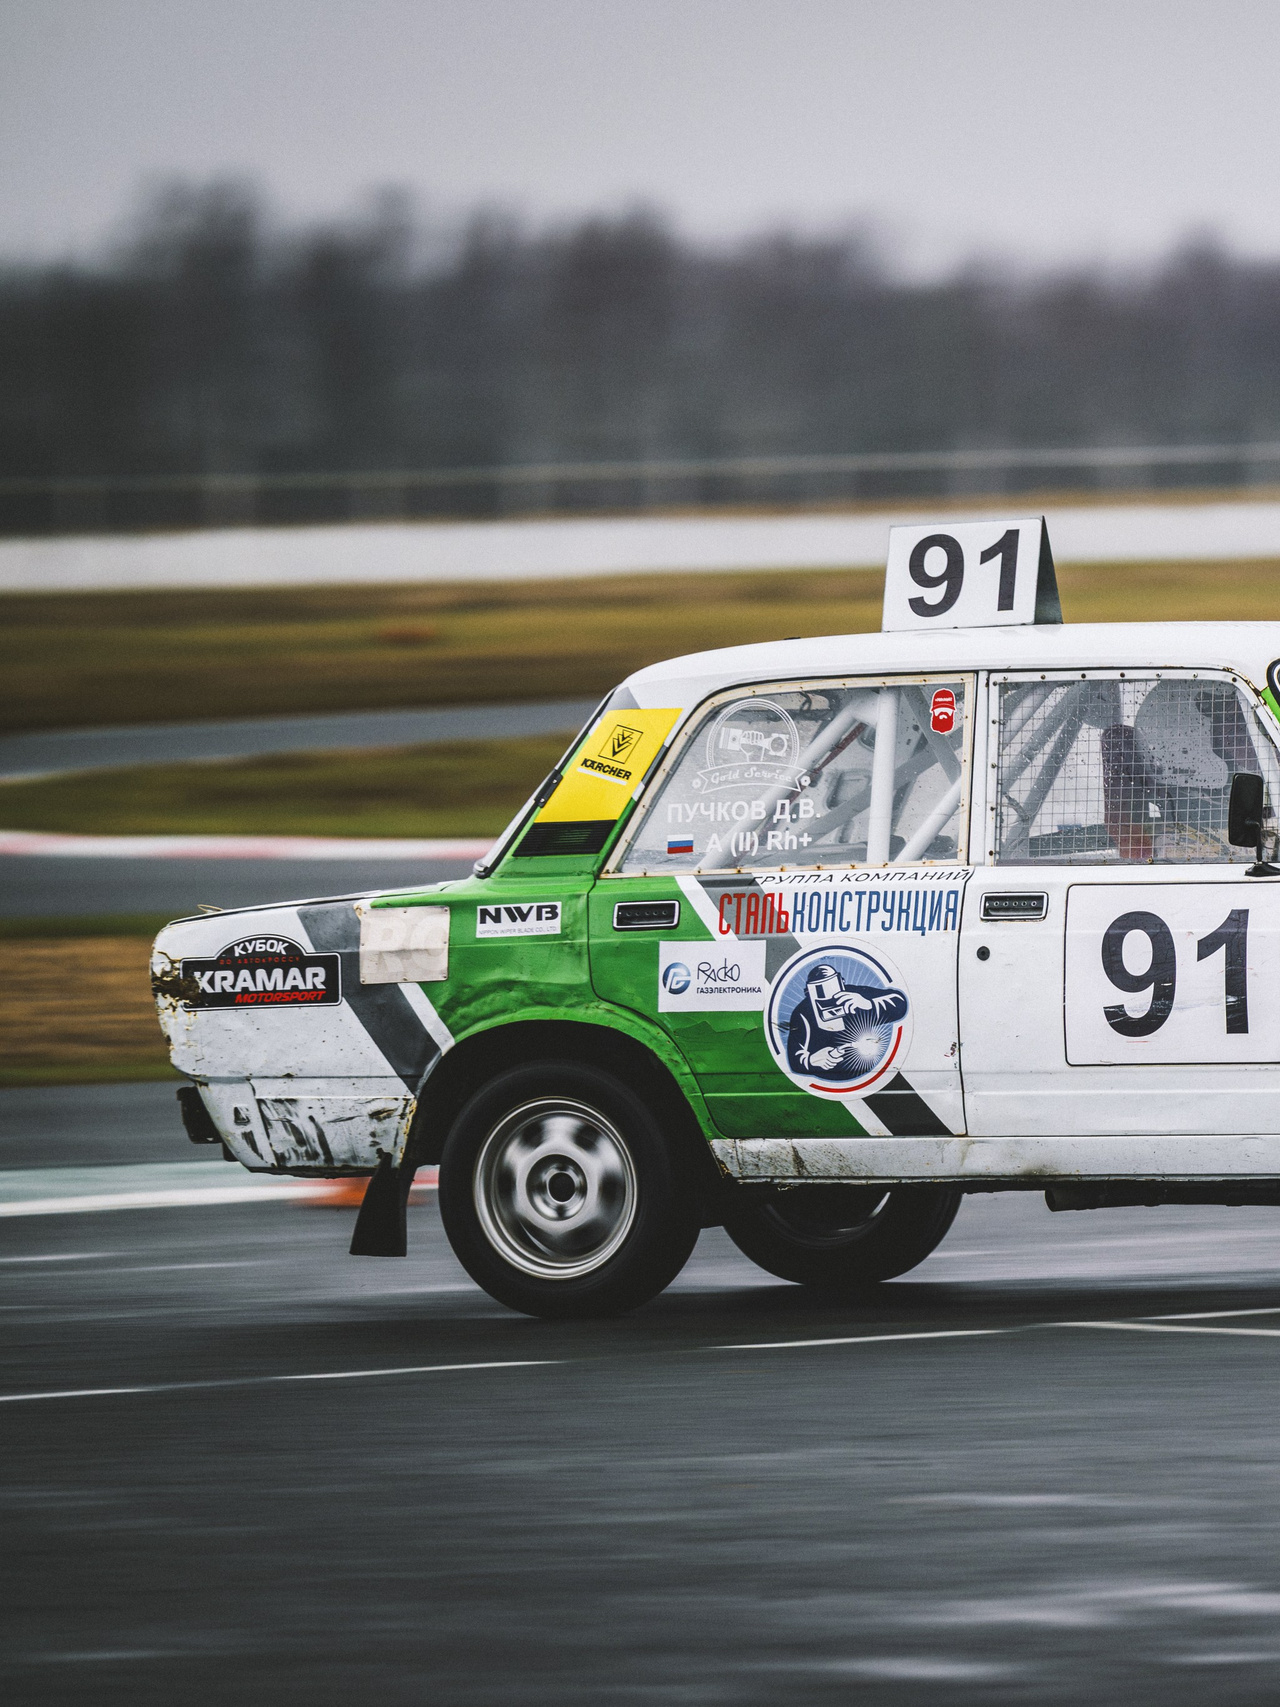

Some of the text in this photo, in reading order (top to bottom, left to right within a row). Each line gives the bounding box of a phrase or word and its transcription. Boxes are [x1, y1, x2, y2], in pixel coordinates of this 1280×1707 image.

[908, 529, 1020, 618] 91
[711, 766, 793, 784] Gold Service
[667, 798, 821, 824] ПУЧКОВ Д.В.
[767, 830, 813, 851] Rh+
[752, 867, 971, 885] ГРУППА КОМПАНИЙ
[479, 904, 559, 925] NWB
[718, 889, 960, 937] СТАЛЬКОНСТРУКЦИЯ
[233, 939, 290, 957] КУБОК
[193, 966, 327, 994] KRAMAR
[1101, 908, 1250, 1038] 91
[235, 991, 327, 1004] MOTORSPORT
[696, 986, 762, 995] ГАЗЭЛЕКТРОНИКА
